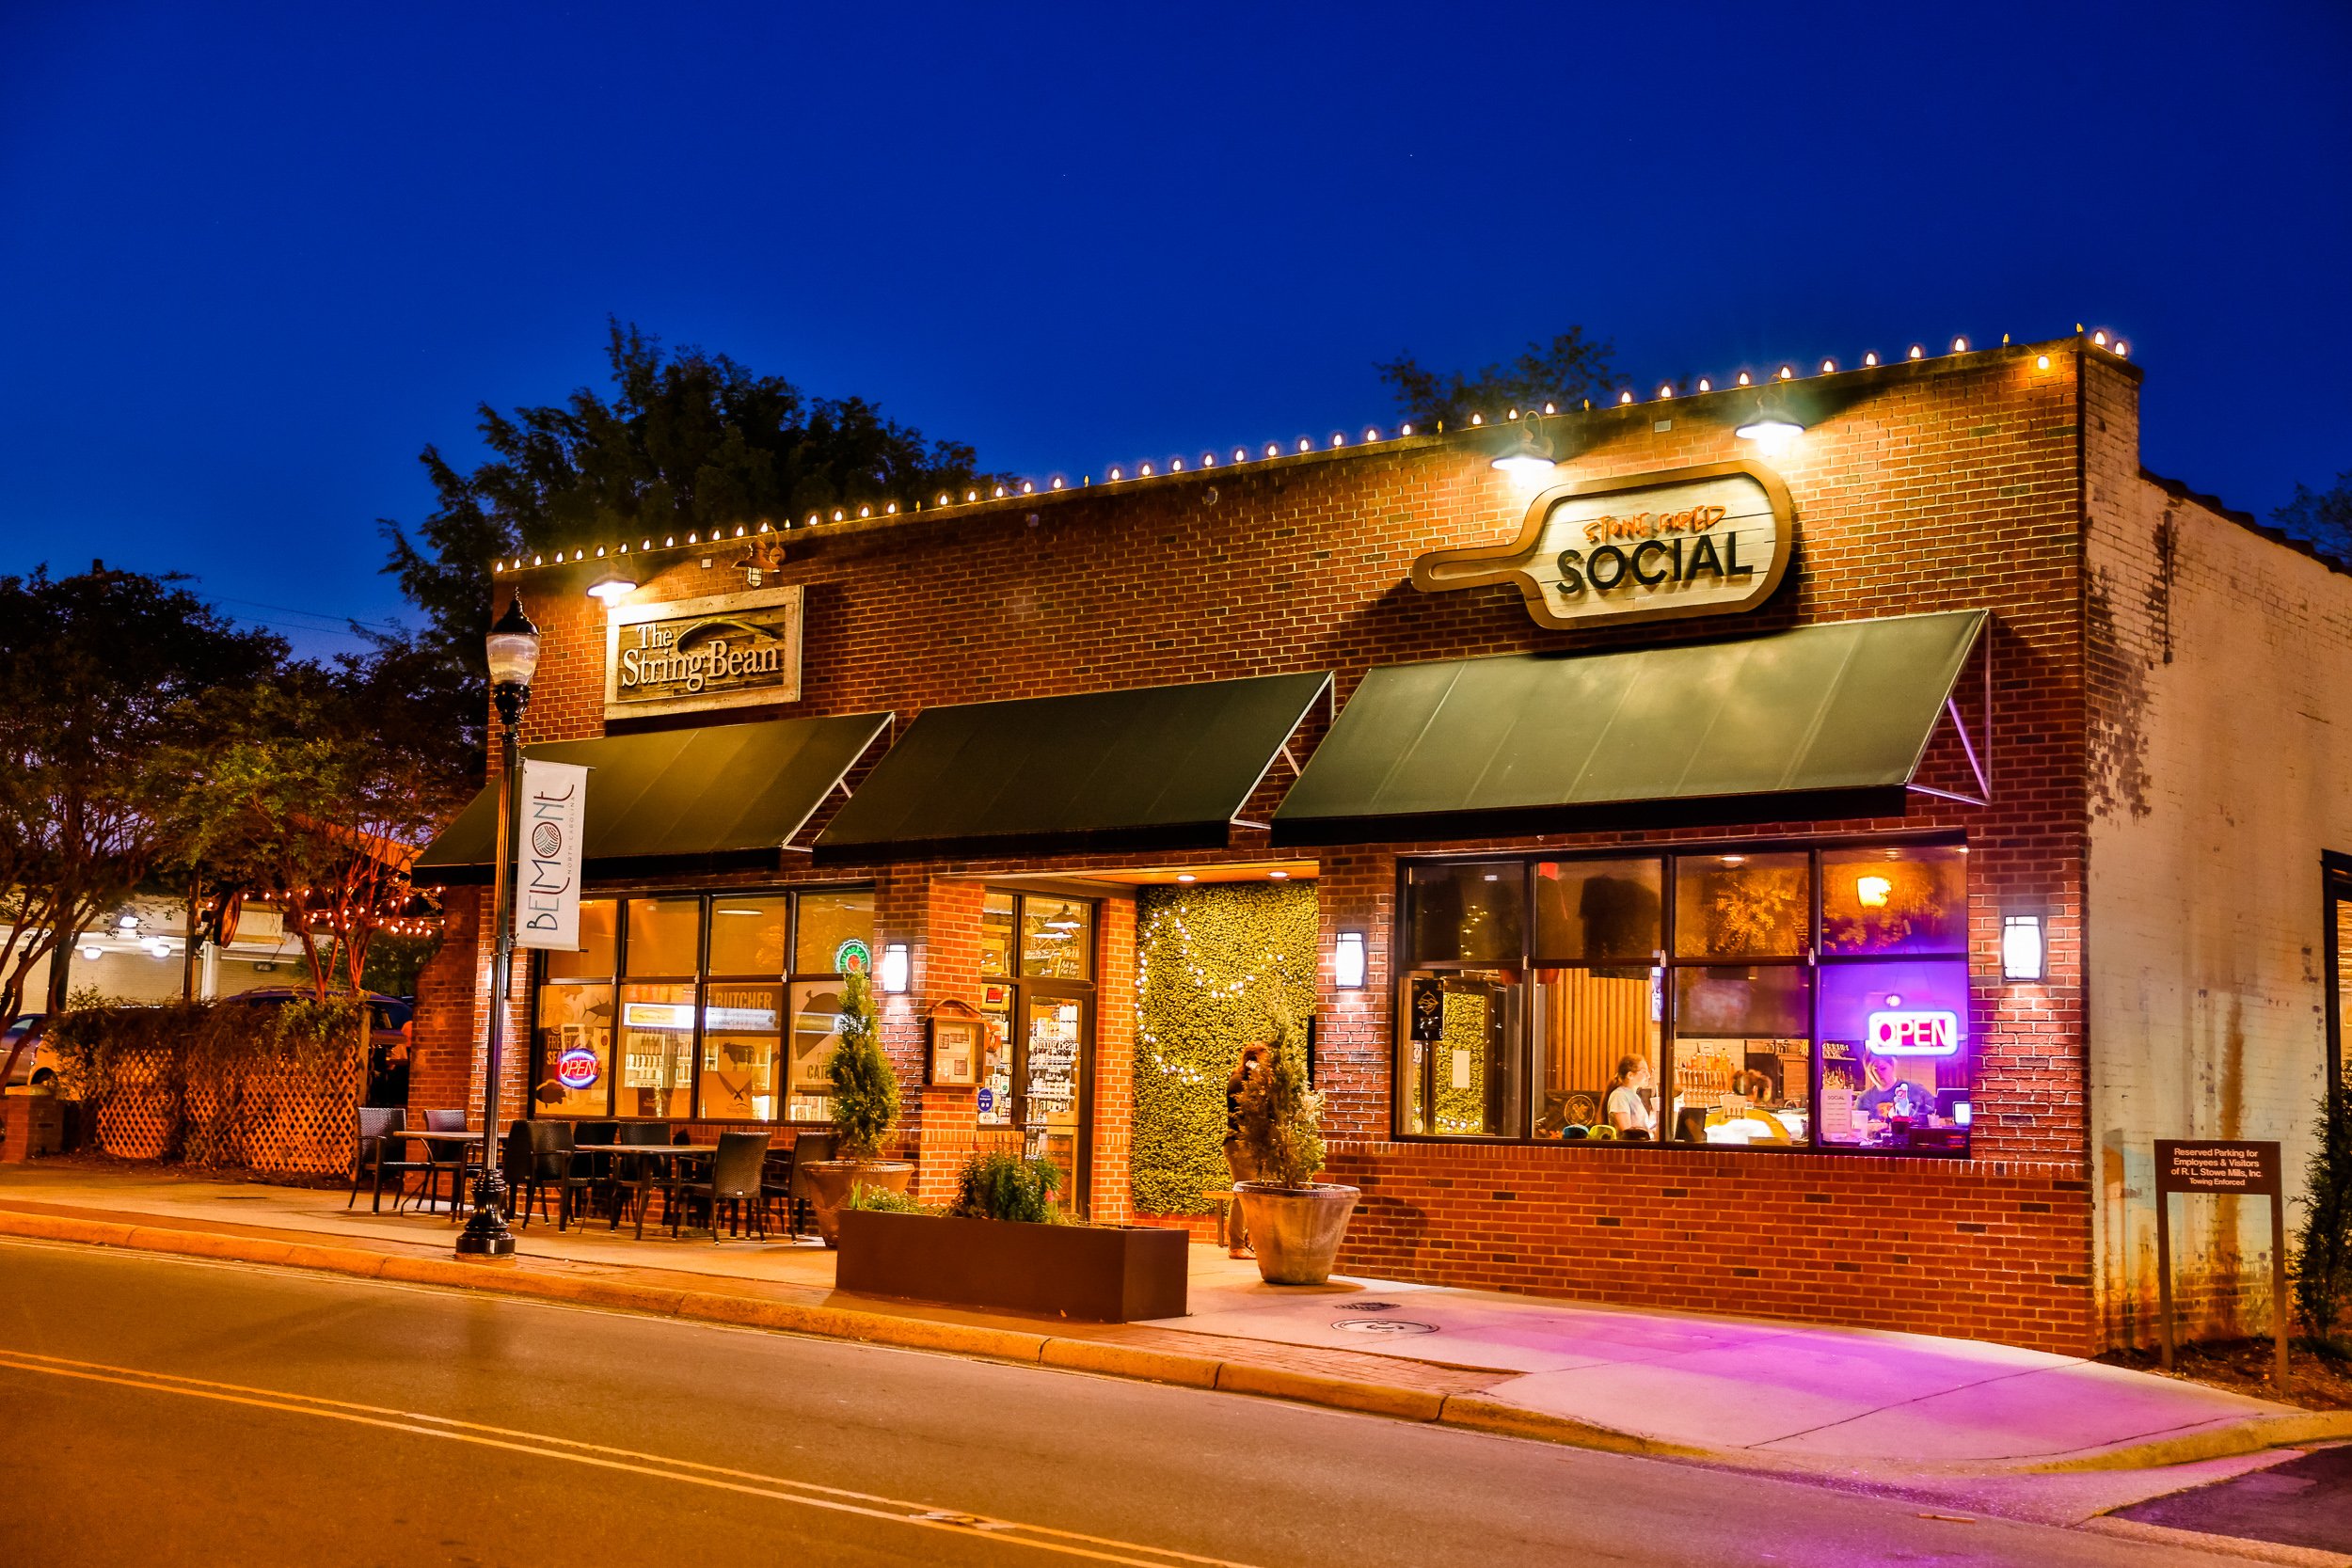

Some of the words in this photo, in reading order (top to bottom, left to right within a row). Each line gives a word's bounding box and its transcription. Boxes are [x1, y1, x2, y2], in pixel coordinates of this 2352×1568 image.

[1582, 513, 1649, 543] STONE
[1659, 504, 1726, 534] FIRED
[1556, 531, 1754, 594] SOCIAL
[637, 624, 675, 650] The
[715, 991, 772, 1009] BUTCHER
[1877, 1018, 1950, 1047] OPEN
[547, 1035, 572, 1050] FREH
[560, 1059, 596, 1077] OPEN
[806, 1064, 832, 1080] CATE
[2174, 1148, 2213, 1157] Reserved
[2214, 1148, 2245, 1158] Parking
[2247, 1149, 2259, 1158] for
[2173, 1158, 2218, 1167] Employees
[2229, 1159, 2260, 1167] Visitors
[2170, 1167, 2180, 1176] of
[2200, 1168, 2226, 1177] Stowe
[2228, 1169, 2248, 1179] Mills,
[2249, 1169, 2264, 1178] Inc.
[2189, 1178, 2213, 1186] Towing
[2214, 1178, 2246, 1186] Enforced
